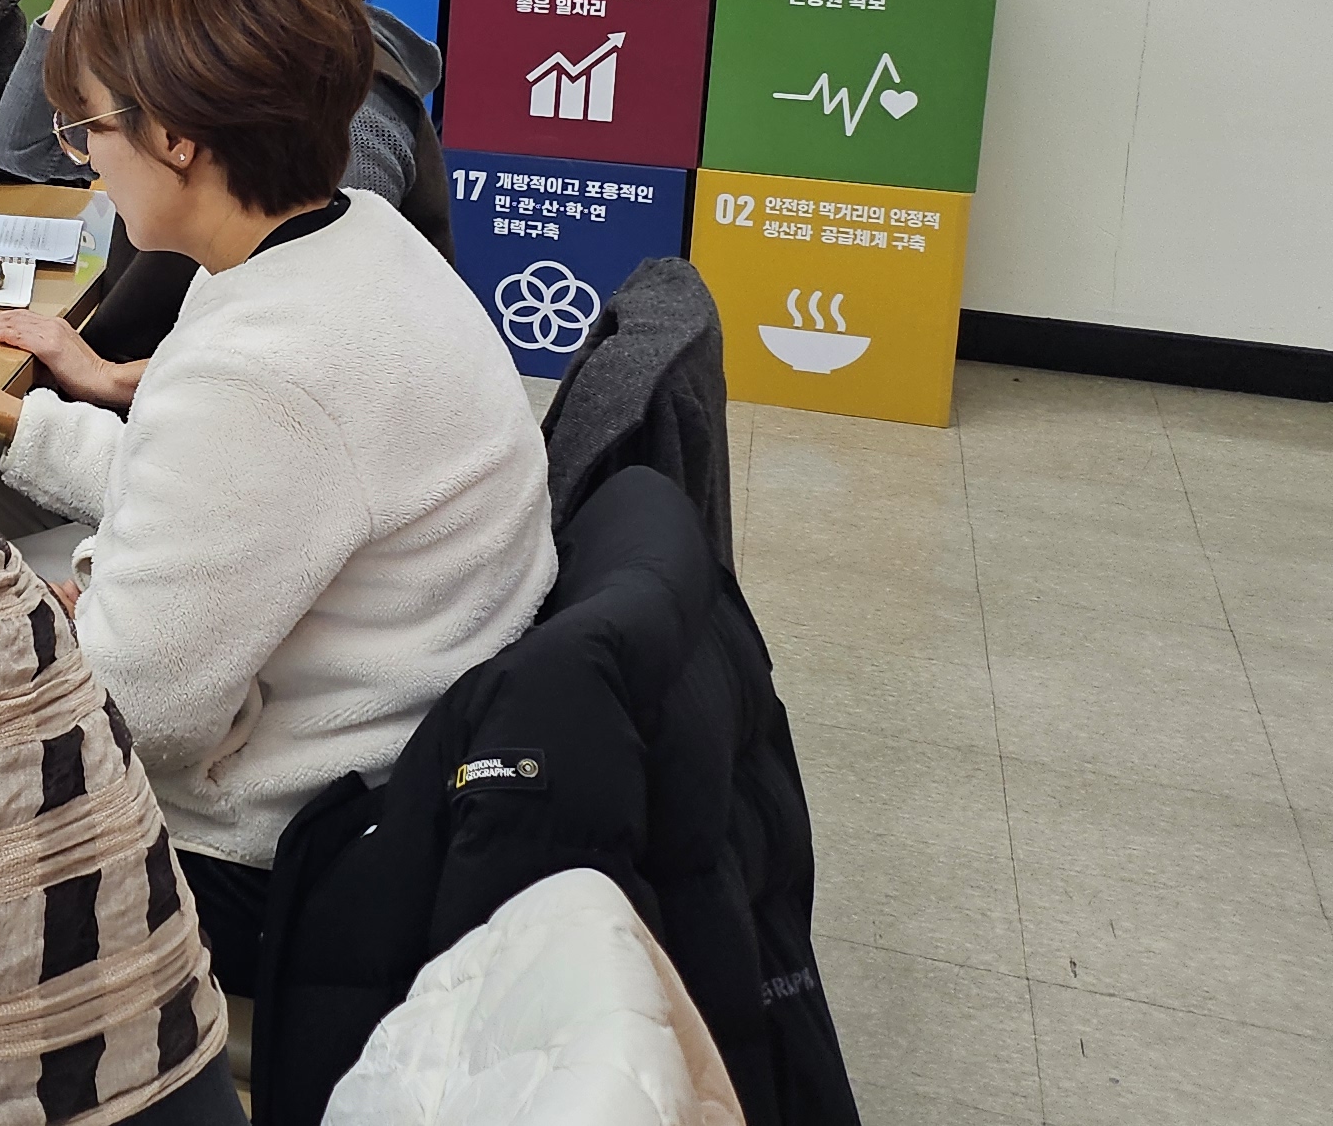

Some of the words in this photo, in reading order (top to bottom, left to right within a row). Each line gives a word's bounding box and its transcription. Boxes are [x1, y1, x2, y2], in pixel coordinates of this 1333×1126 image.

[452, 169, 487, 201] 17
[496, 172, 580, 196] 개방적이고
[585, 180, 654, 204] 포용적인
[715, 193, 755, 227] 02
[765, 196, 814, 218] 안전한
[819, 201, 885, 225] 먹거리의
[890, 209, 941, 230] 안정적
[493, 218, 560, 241] 협력구축
[763, 220, 813, 241] 생산과
[821, 225, 888, 249] 공급체계
[892, 232, 926, 253] 구축
[465, 768, 516, 781] GEOGRAPHIC
[466, 758, 503, 771] NATIONAL
